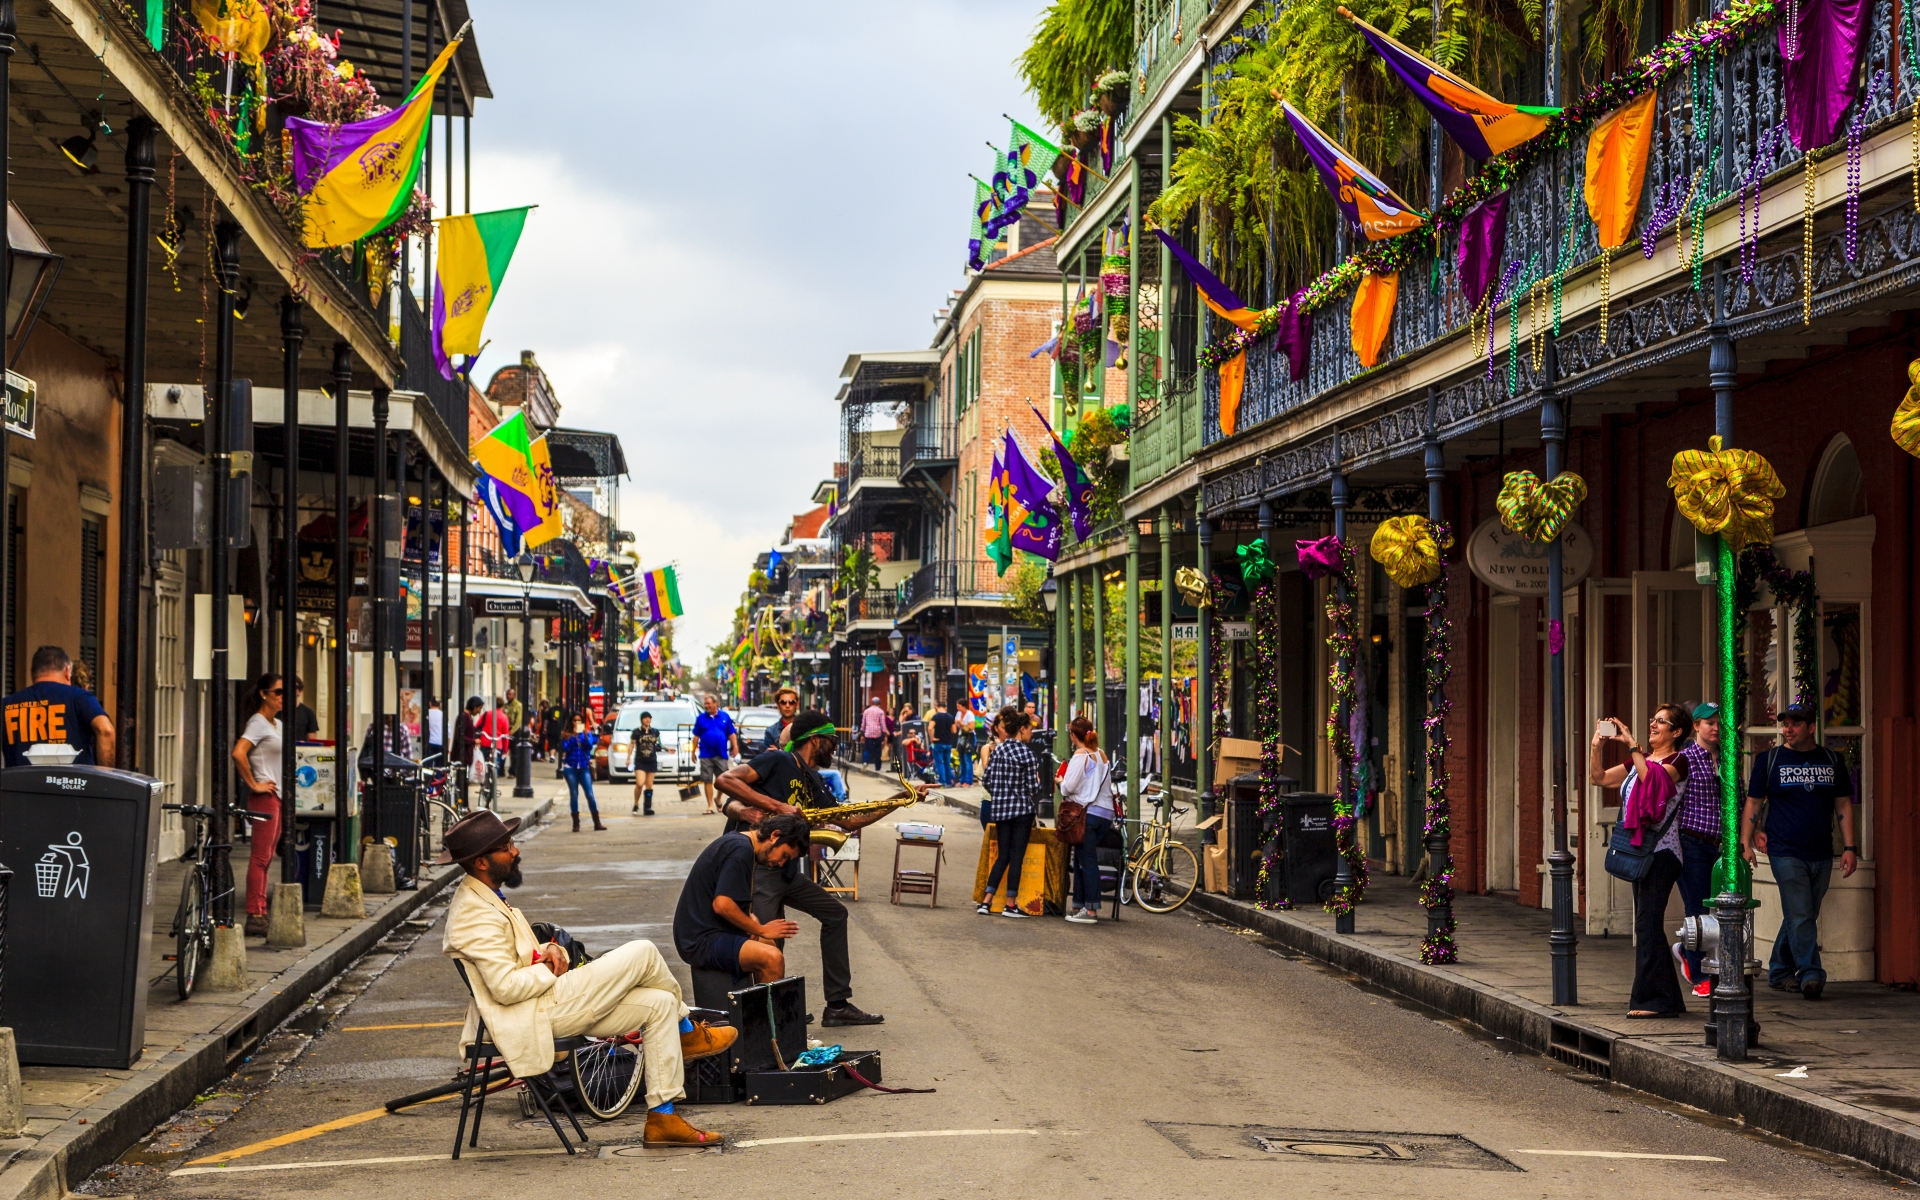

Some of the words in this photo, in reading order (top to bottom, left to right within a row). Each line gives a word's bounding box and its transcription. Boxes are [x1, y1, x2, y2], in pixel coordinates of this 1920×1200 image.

[5, 390, 28, 424] Royal
[1489, 564, 1516, 574] NEW
[1515, 580, 1527, 588] Est.
[1530, 580, 1547, 588] 2007
[1231, 628, 1250, 637] Trade
[5, 704, 67, 745] FIRE
[1780, 767, 1835, 776] SPORTING
[46, 776, 87, 786] BigBelly
